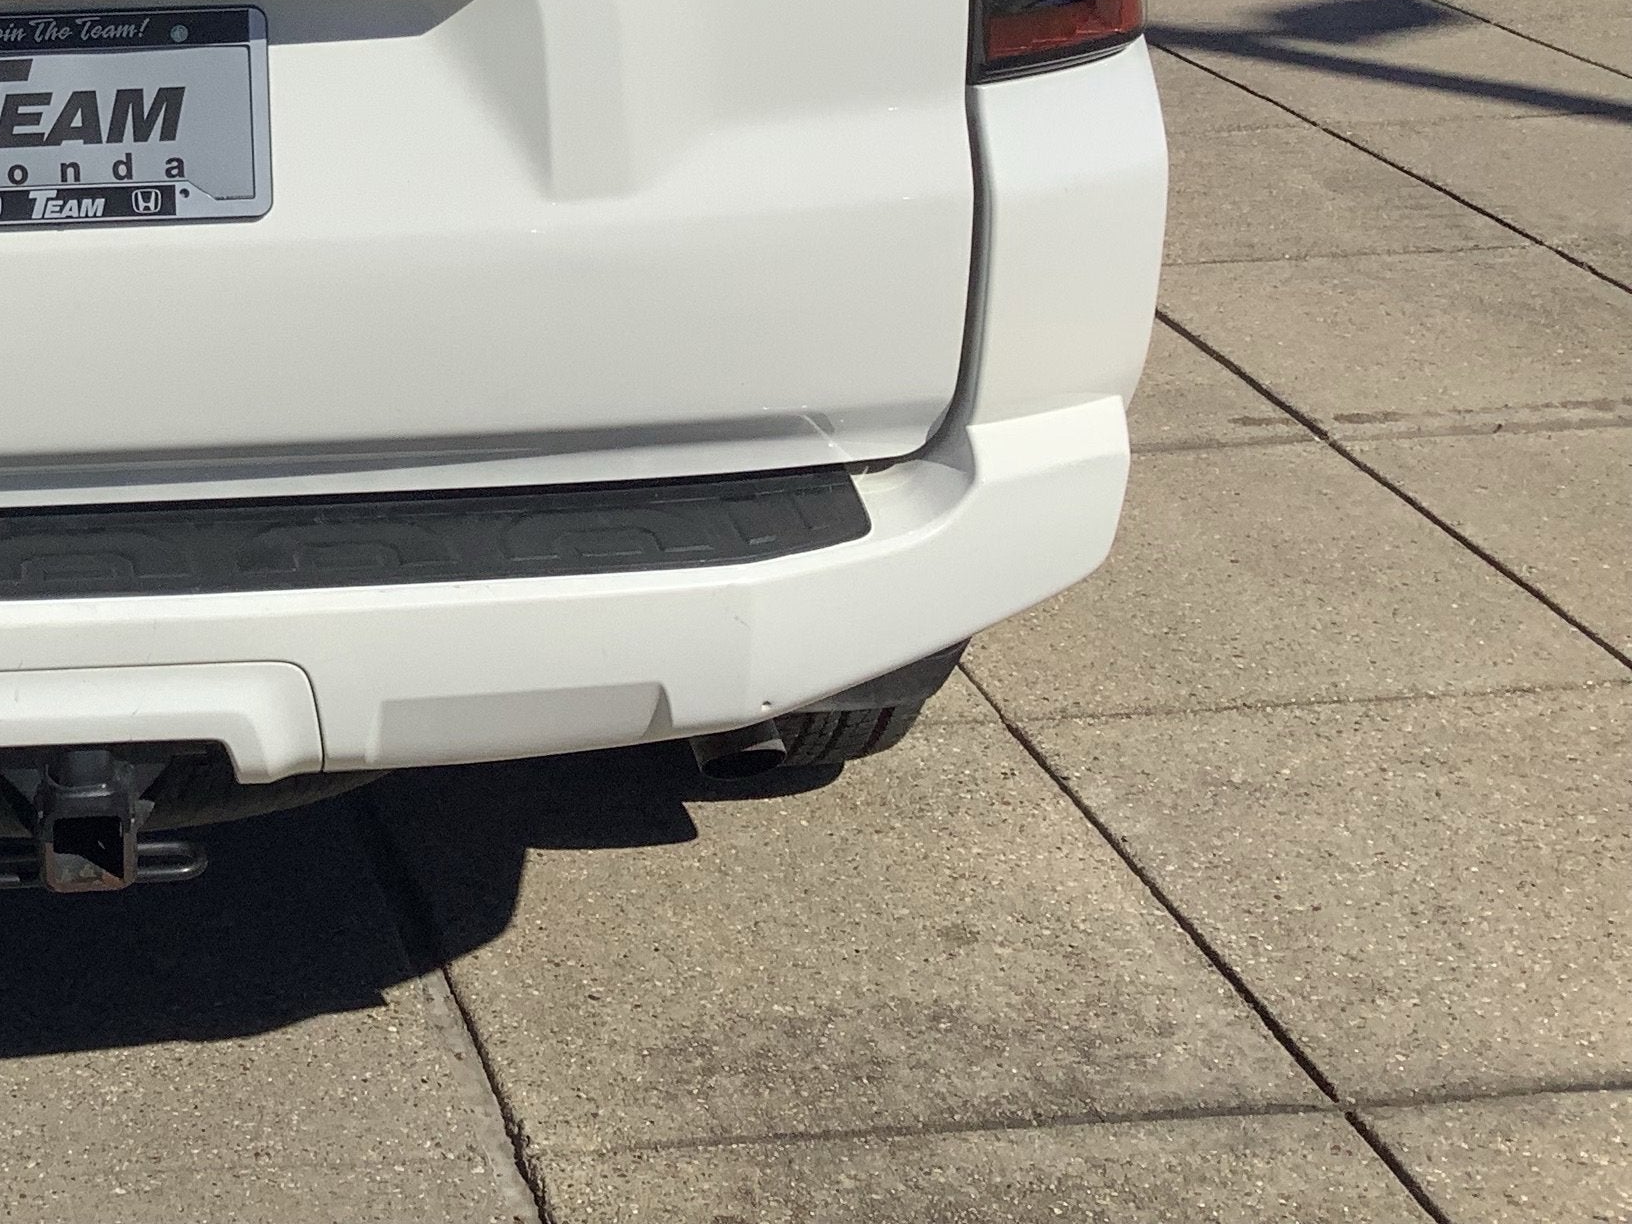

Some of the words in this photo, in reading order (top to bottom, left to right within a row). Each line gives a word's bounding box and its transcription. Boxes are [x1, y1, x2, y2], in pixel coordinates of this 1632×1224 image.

[29, 18, 72, 43] The
[76, 16, 150, 42] Team!
[28, 189, 105, 219] TEAM
